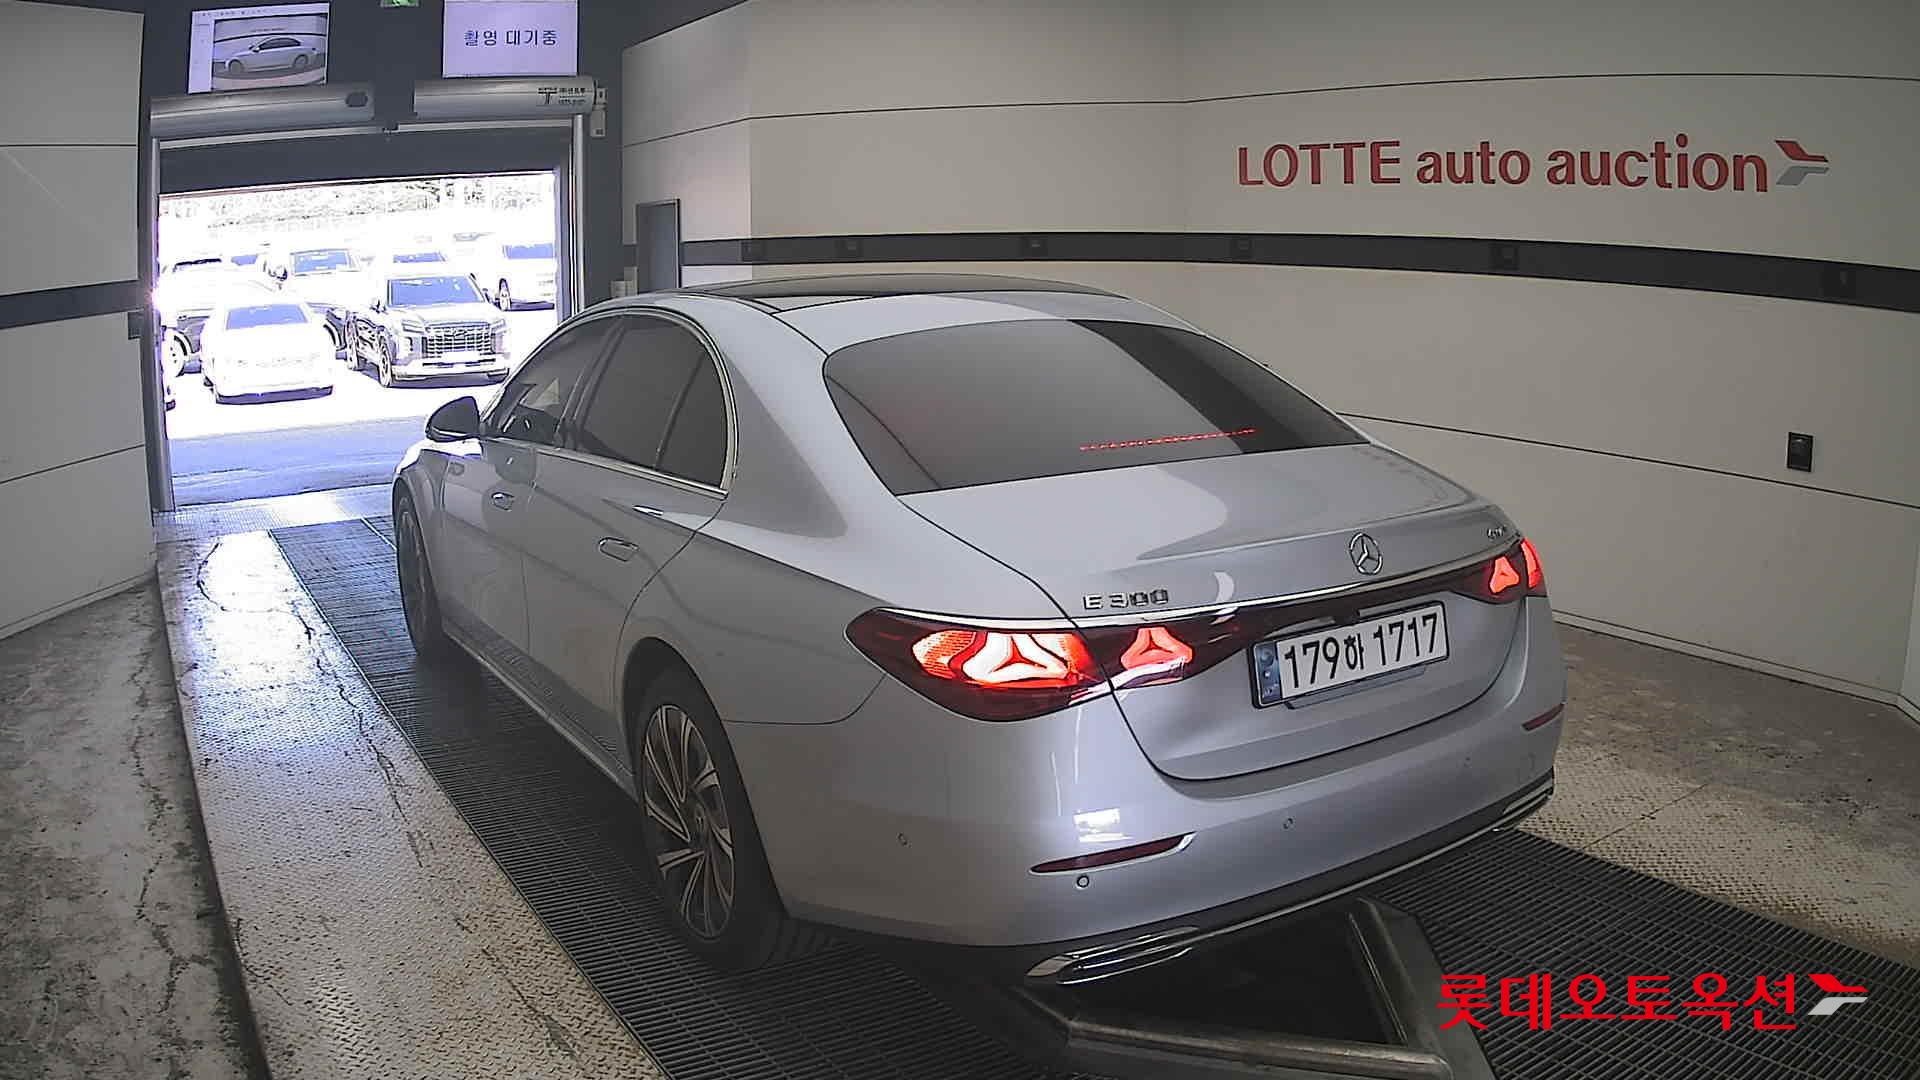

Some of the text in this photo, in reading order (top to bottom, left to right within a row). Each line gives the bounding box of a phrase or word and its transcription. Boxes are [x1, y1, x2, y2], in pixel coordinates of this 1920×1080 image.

[463, 29, 558, 46] 촬영 대기중
[1238, 133, 1769, 193] LOTTE auto auction
[1083, 588, 1170, 610] E 300
[1283, 612, 1438, 689] 179하 1717
